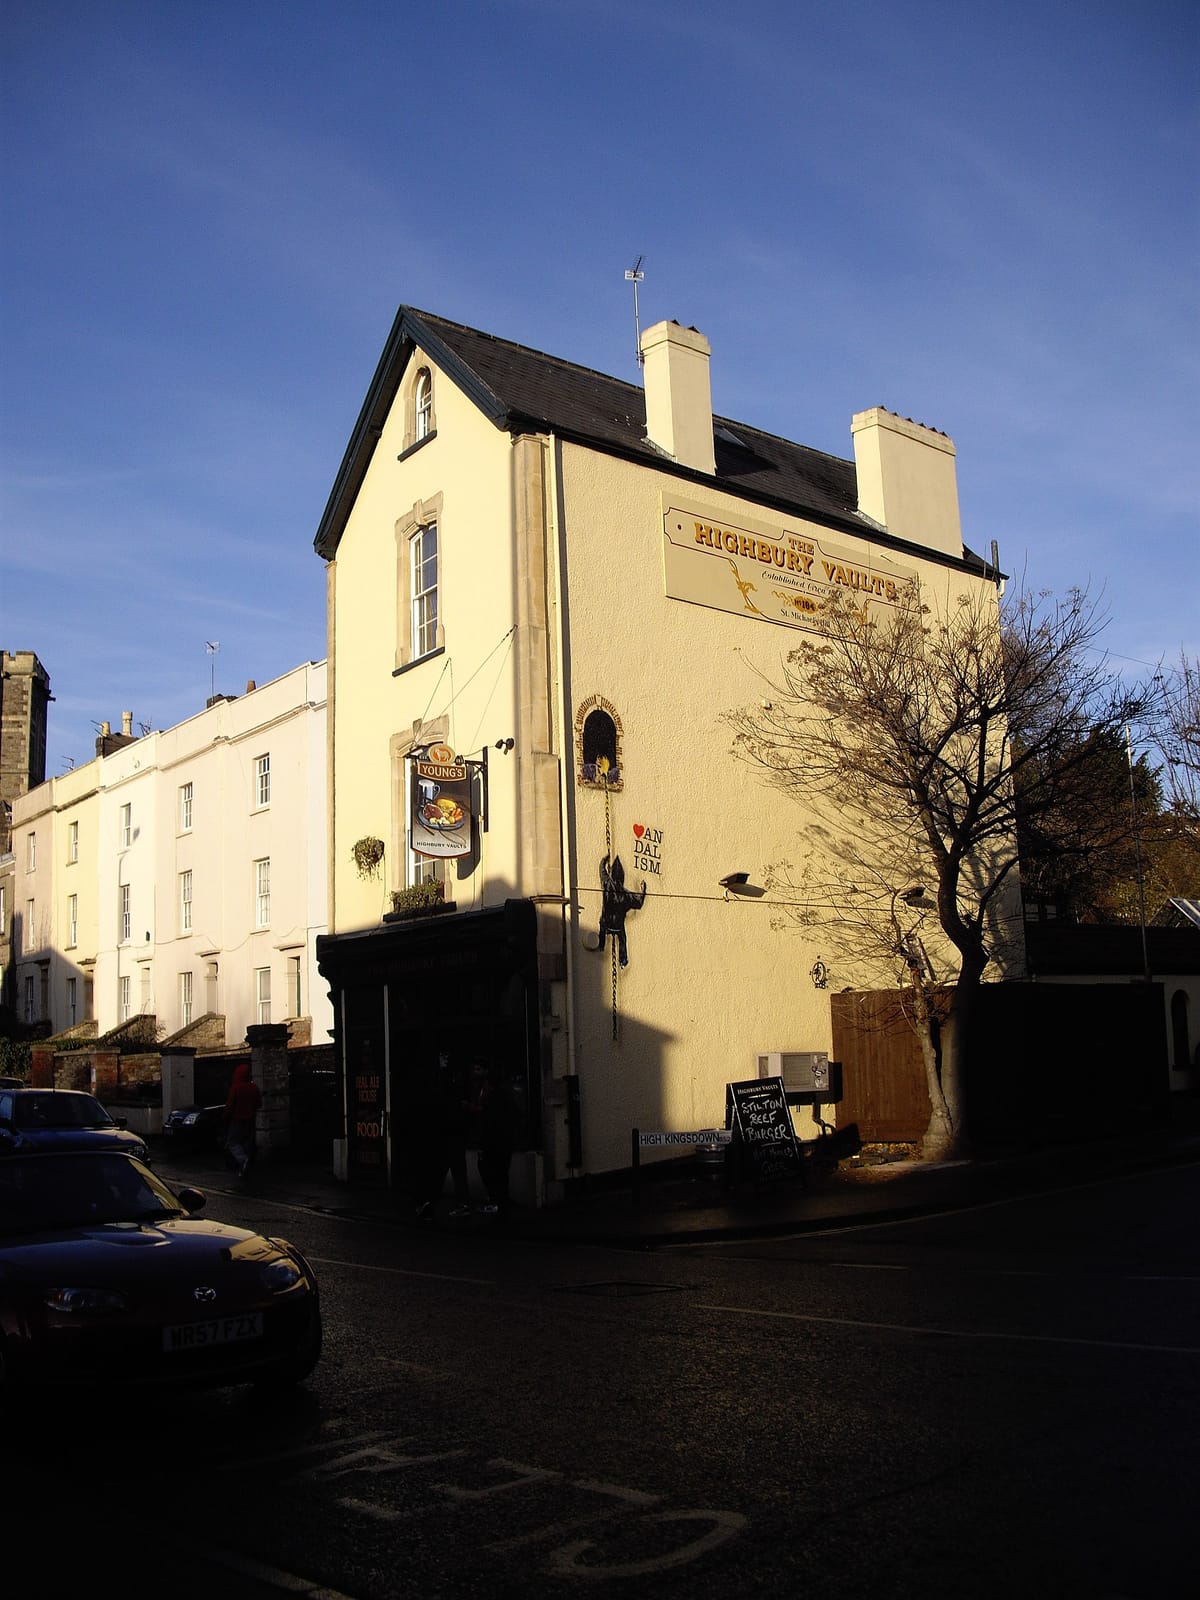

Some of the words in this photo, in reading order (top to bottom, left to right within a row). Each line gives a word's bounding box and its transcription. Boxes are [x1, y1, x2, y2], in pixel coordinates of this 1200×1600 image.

[788, 536, 815, 556] THE
[694, 522, 814, 577] HIGHBURY
[821, 560, 898, 602] VAULTS
[761, 570, 805, 588] Established
[422, 765, 463, 778] YOUNG'S
[634, 839, 662, 859] DAL
[634, 855, 662, 875] ISM
[741, 1096, 783, 1114] STILTON
[749, 1111, 777, 1126] BEEF
[640, 1134, 662, 1145] HIGH
[664, 1132, 720, 1145] KINGSDOWN
[744, 1124, 792, 1143] BURGER
